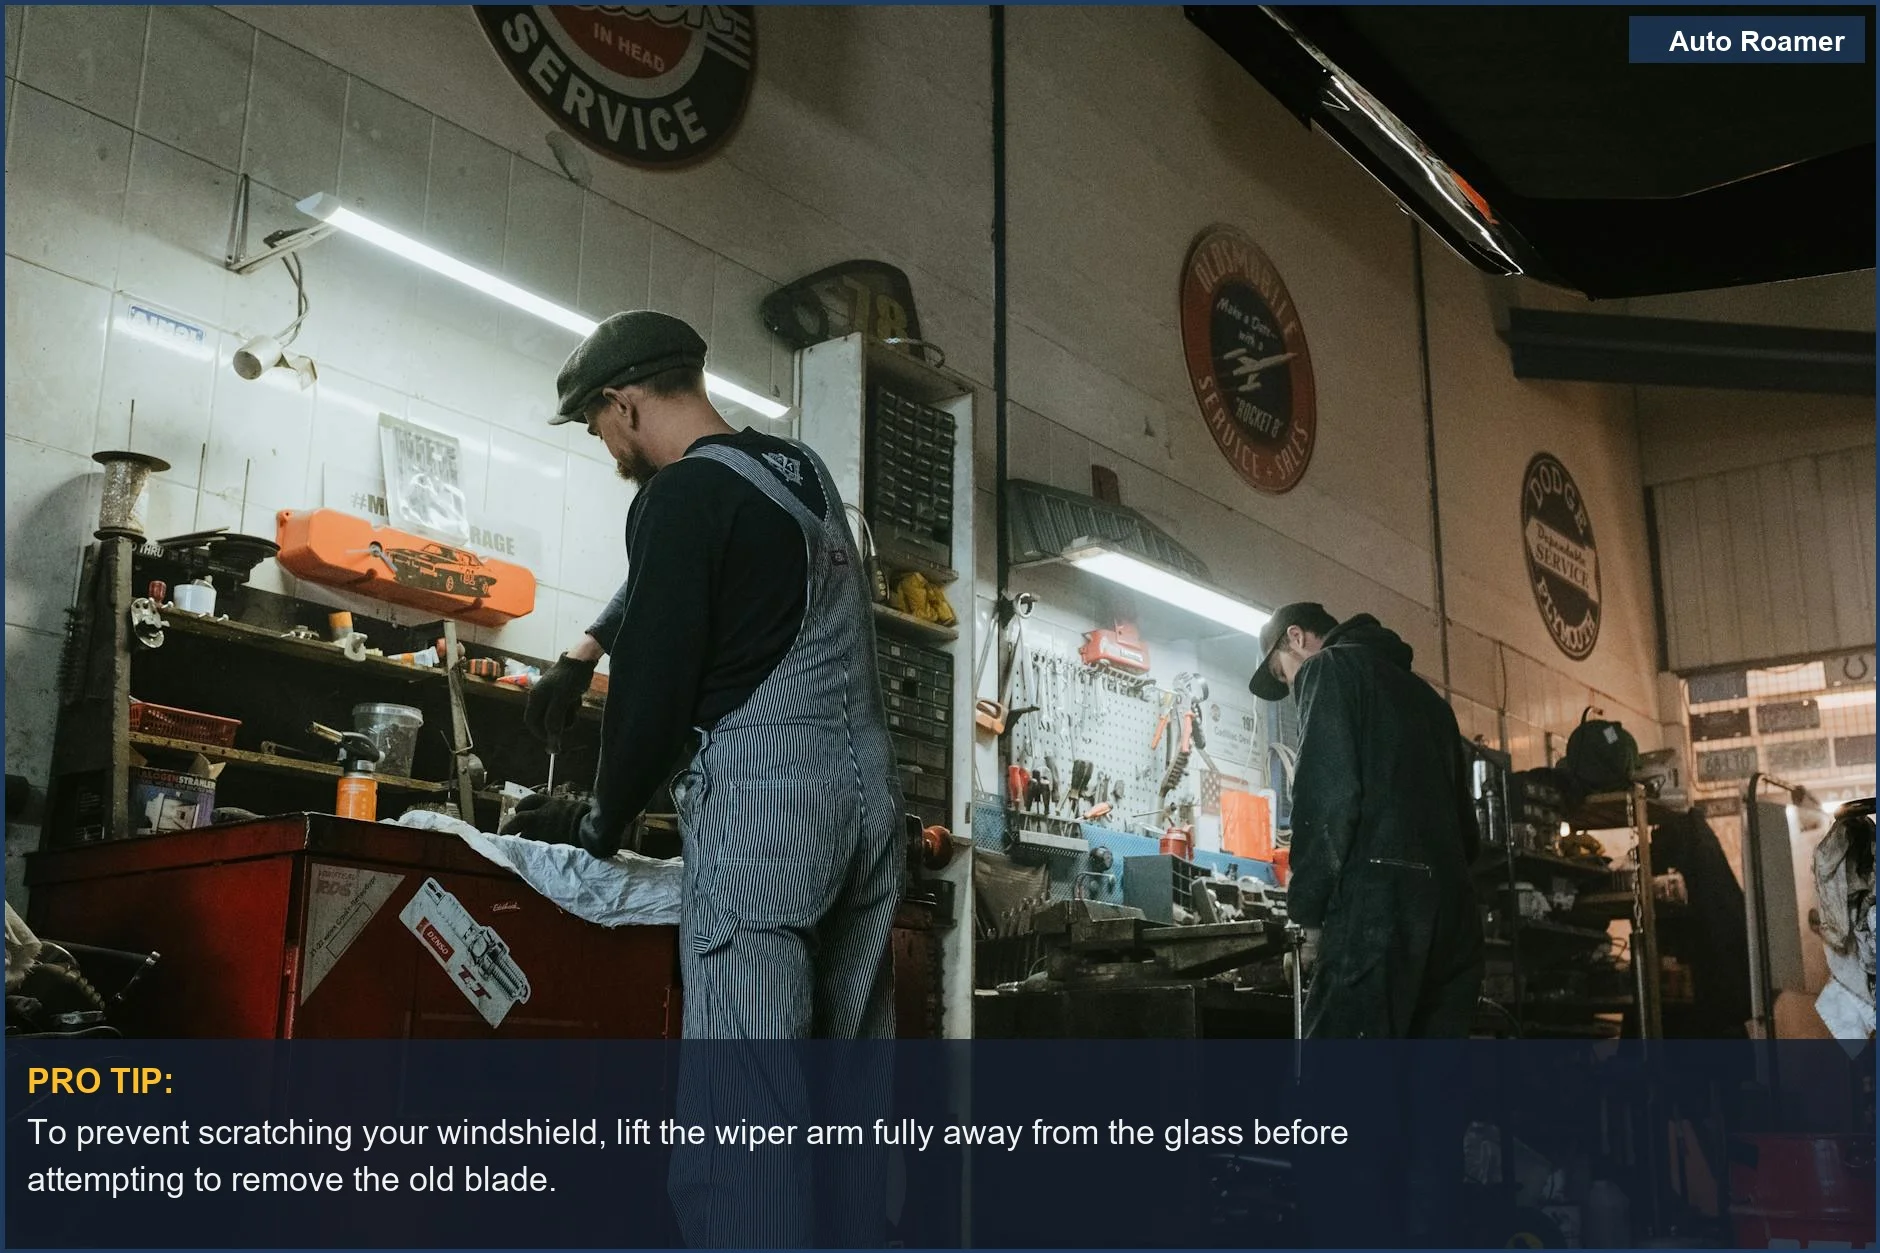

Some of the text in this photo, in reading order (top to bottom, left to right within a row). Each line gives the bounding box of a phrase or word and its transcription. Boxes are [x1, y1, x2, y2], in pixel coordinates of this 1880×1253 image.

[502, 12, 708, 151] SERVICE
[593, 22, 665, 73] IN HEAD
[1198, 375, 1309, 481] SERVICE SALES
[1530, 464, 1587, 536] DODGE
[1536, 543, 1590, 591] SERVICE
[1536, 575, 1596, 650] PLYMOUTH
[426, 931, 449, 955] DENSO
